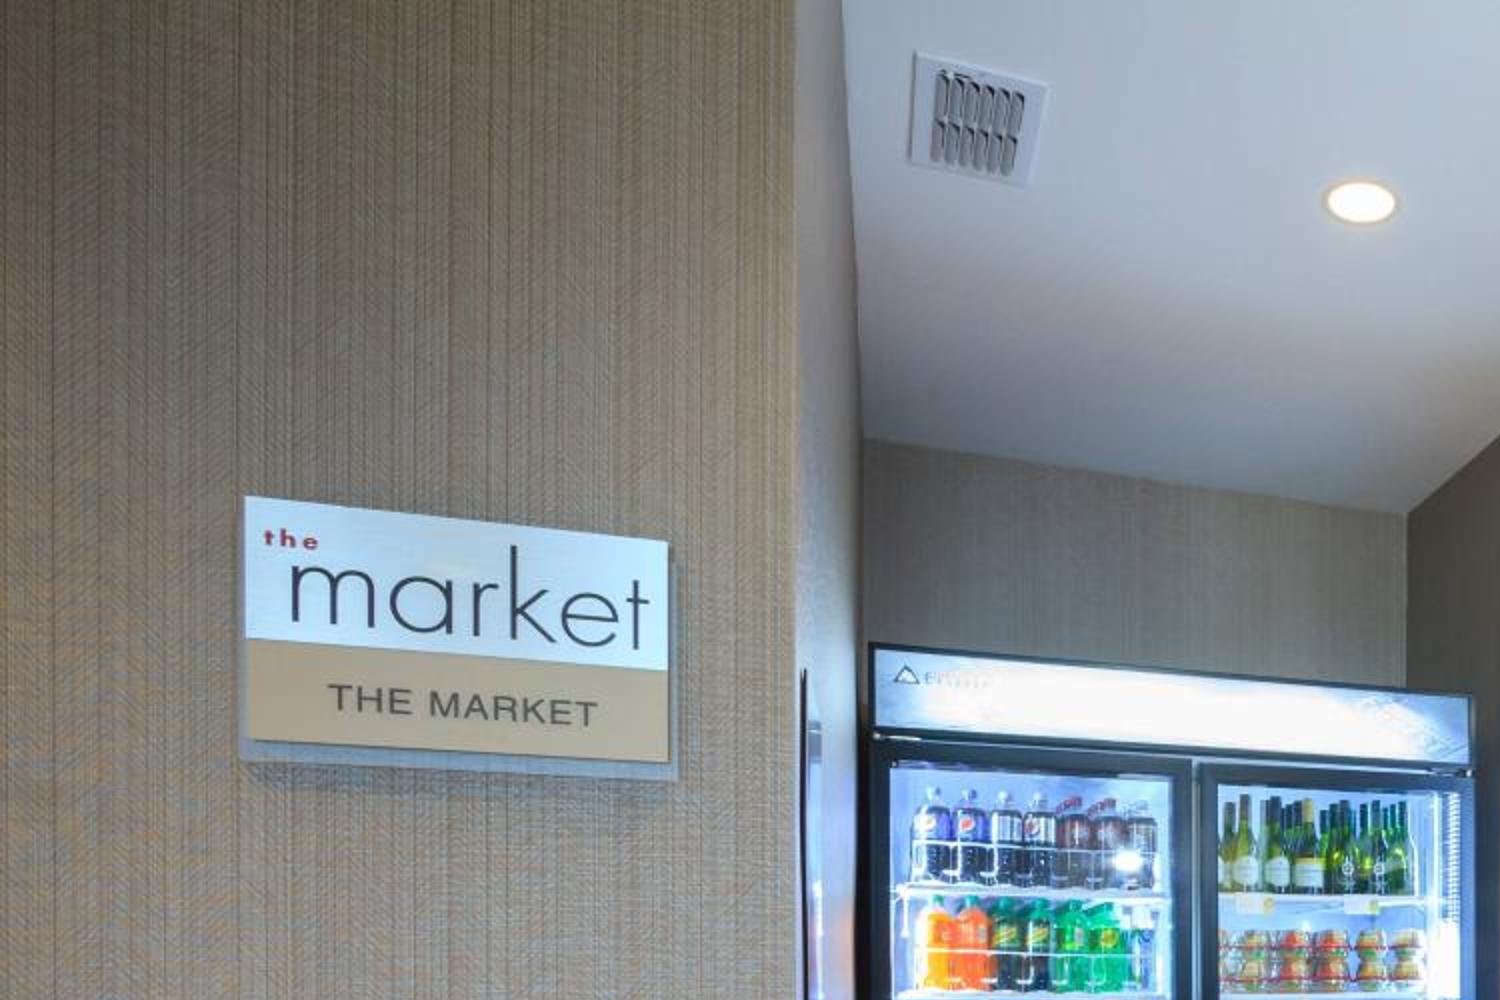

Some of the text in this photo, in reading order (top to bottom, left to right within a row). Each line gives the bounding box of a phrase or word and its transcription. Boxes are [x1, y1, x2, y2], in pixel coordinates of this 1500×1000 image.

[264, 529, 319, 550] the
[291, 545, 650, 650] market
[328, 684, 598, 728] THE MARKET
